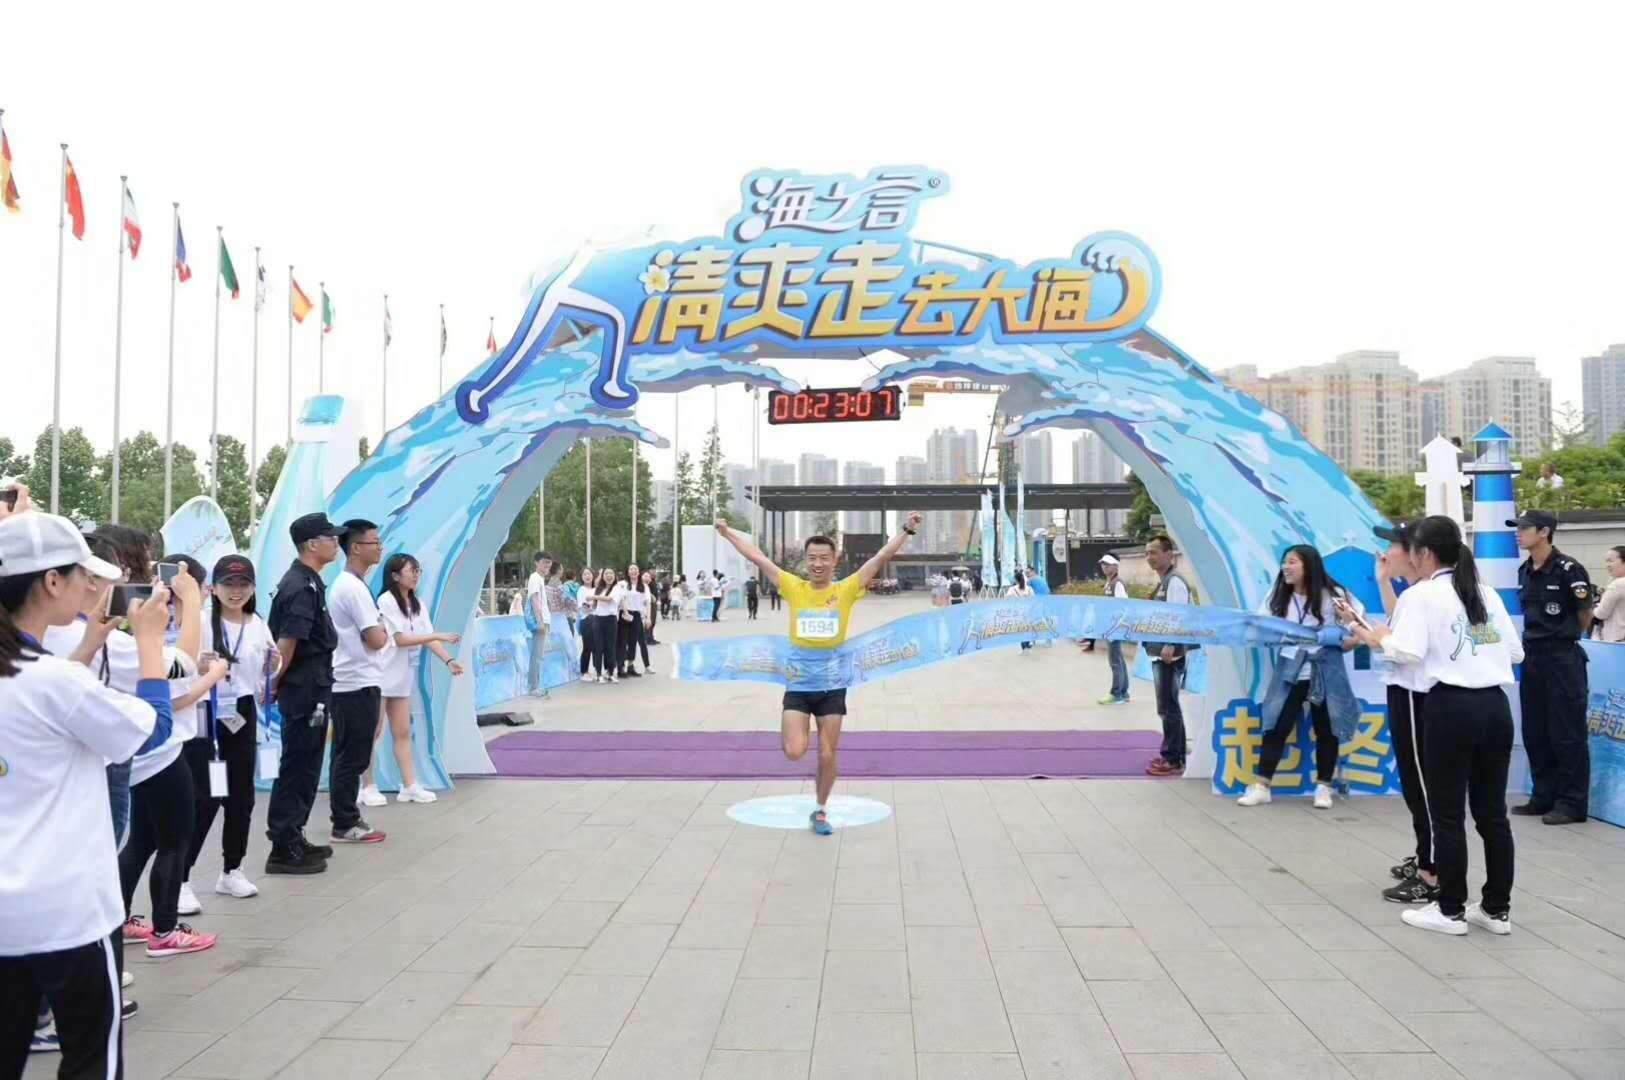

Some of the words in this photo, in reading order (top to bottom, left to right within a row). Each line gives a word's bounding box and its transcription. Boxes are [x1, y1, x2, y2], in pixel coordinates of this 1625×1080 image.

[733, 172, 923, 242] 海之言
[773, 390, 892, 420] 00:23:07
[800, 620, 835, 634] 1594
